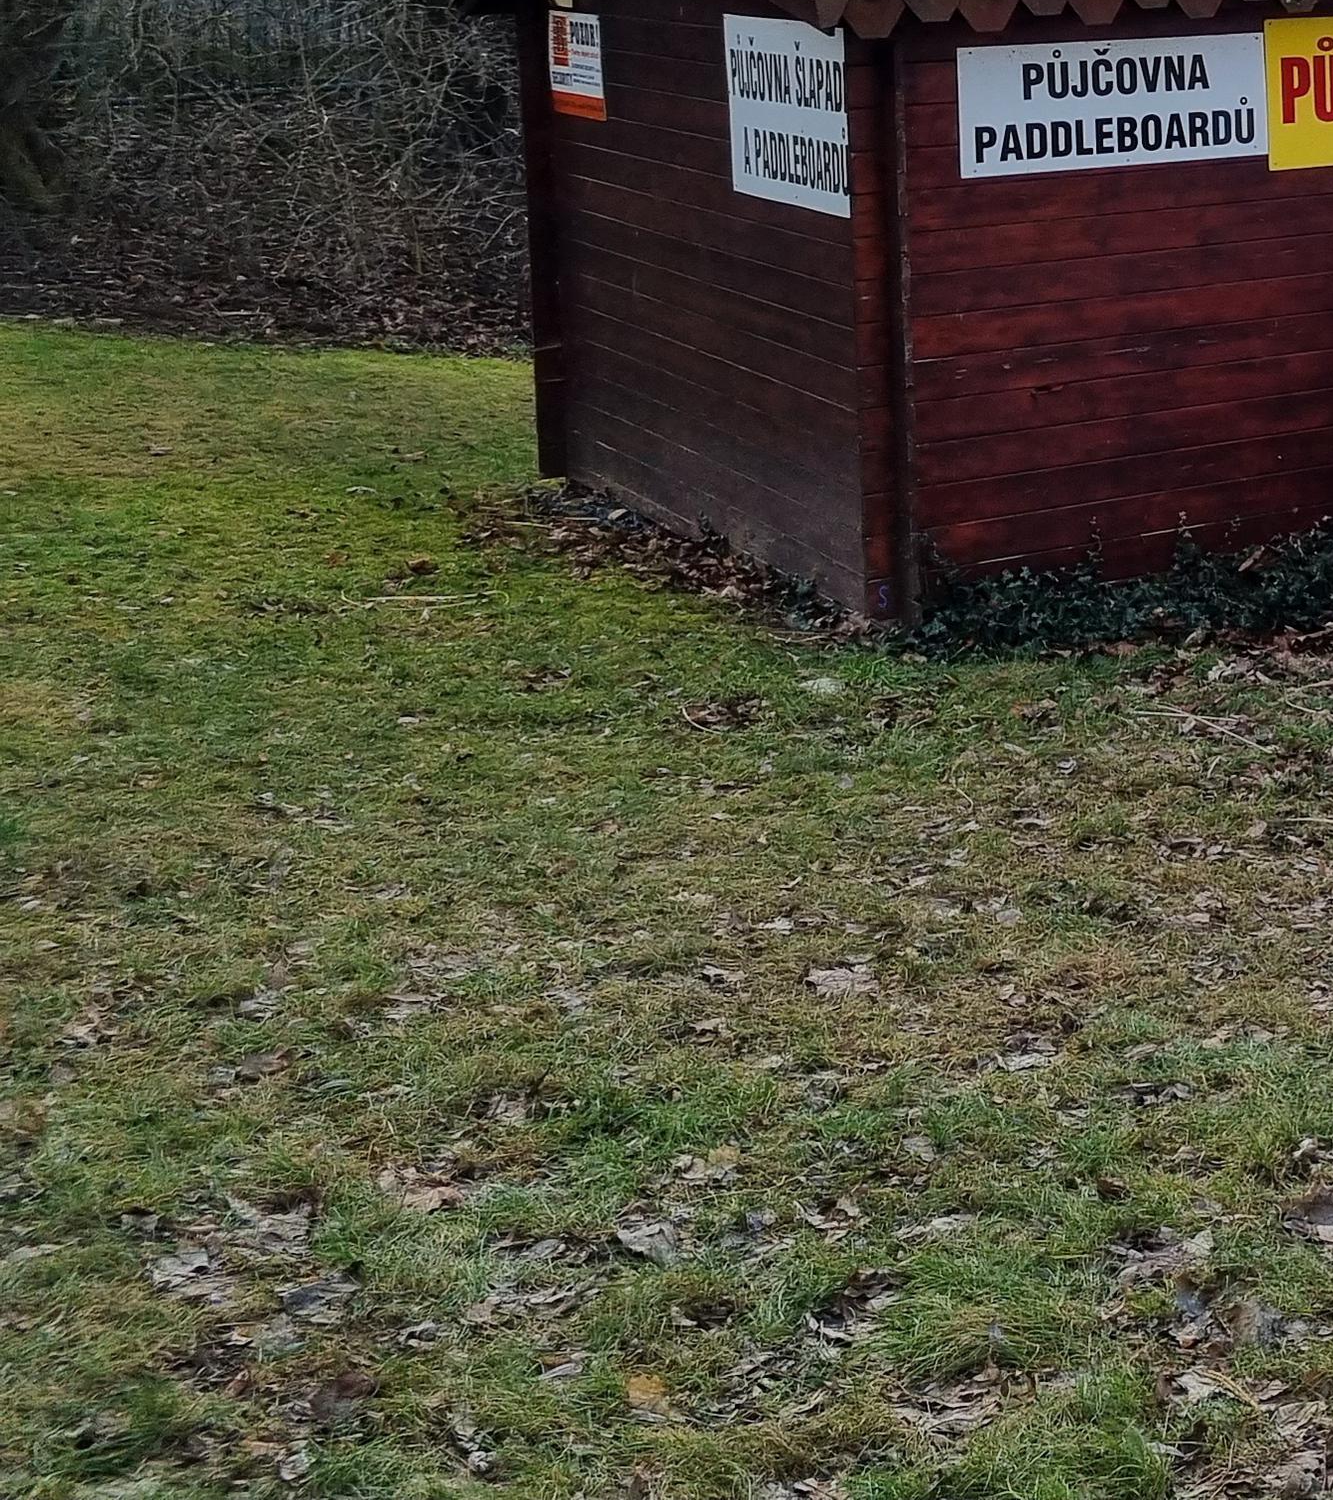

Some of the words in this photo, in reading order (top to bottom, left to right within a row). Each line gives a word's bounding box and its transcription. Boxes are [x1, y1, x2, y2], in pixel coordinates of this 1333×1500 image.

[729, 33, 792, 105] PŮJČOVNA
[1022, 48, 1210, 101] PŮJČOVNA
[743, 126, 752, 175] A
[754, 127, 850, 197] PADDLEBOARDŮ
[974, 96, 1255, 164] PADDLEBOARDŮ
